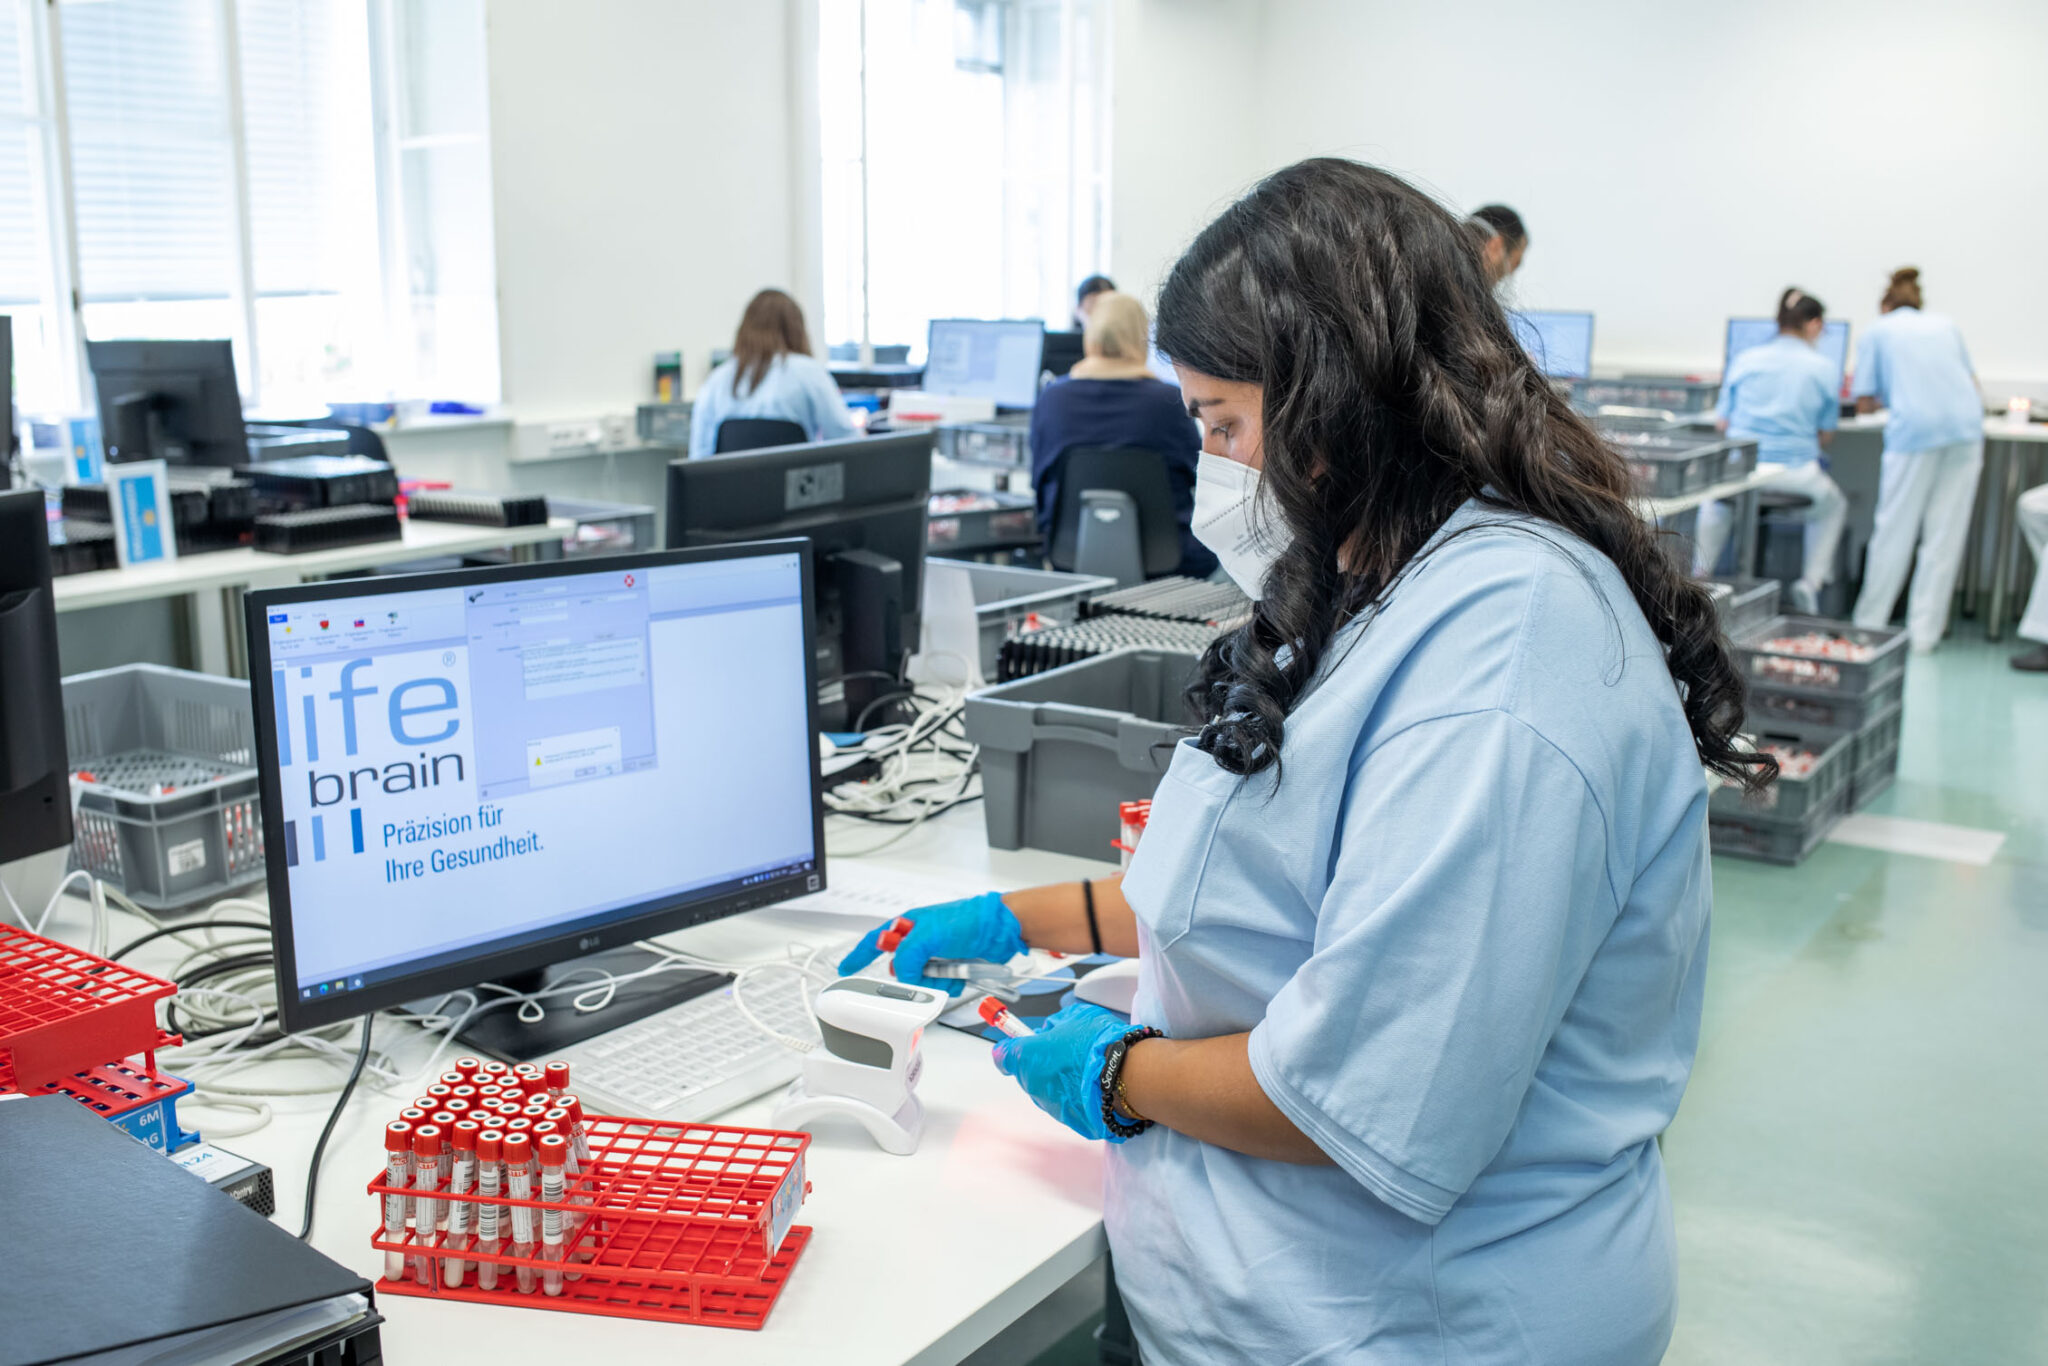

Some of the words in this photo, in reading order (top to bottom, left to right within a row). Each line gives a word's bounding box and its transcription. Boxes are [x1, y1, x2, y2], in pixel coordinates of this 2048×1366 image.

[273, 657, 460, 766] life
[309, 750, 464, 808] brain
[383, 813, 472, 848] Präzision
[478, 804, 504, 829] für
[385, 859, 425, 883] Ihre
[431, 830, 545, 874] Gesundheit.
[1102, 1050, 1121, 1089] Senem
[139, 1109, 159, 1127] 6M
